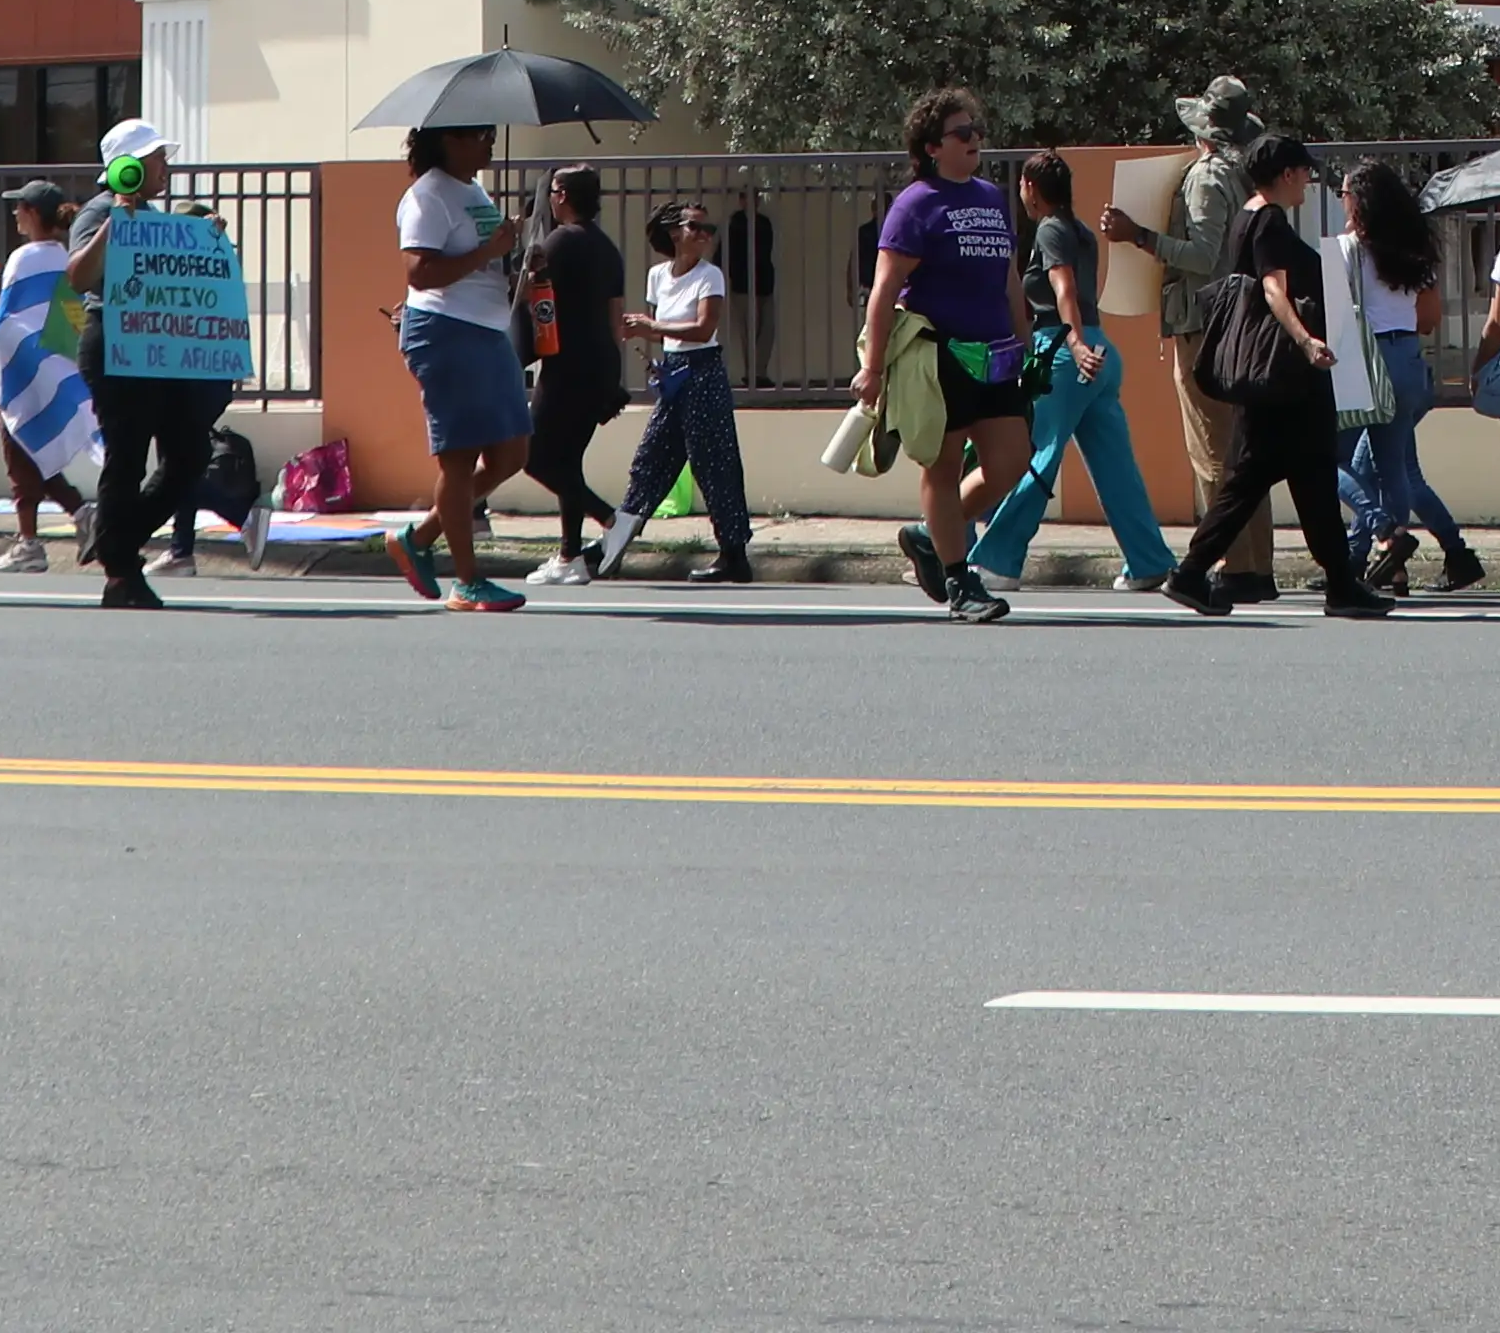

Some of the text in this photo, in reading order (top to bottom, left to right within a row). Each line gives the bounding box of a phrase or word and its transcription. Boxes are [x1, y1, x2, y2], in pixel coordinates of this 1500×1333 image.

[946, 207, 1003, 222] RESISTIMOS
[960, 246, 998, 258] NUNCA
[133, 252, 231, 279] EMPOBRECEN
[144, 286, 218, 309] NATIVO
[146, 344, 168, 367] DE
[180, 347, 244, 372] AFUERA
